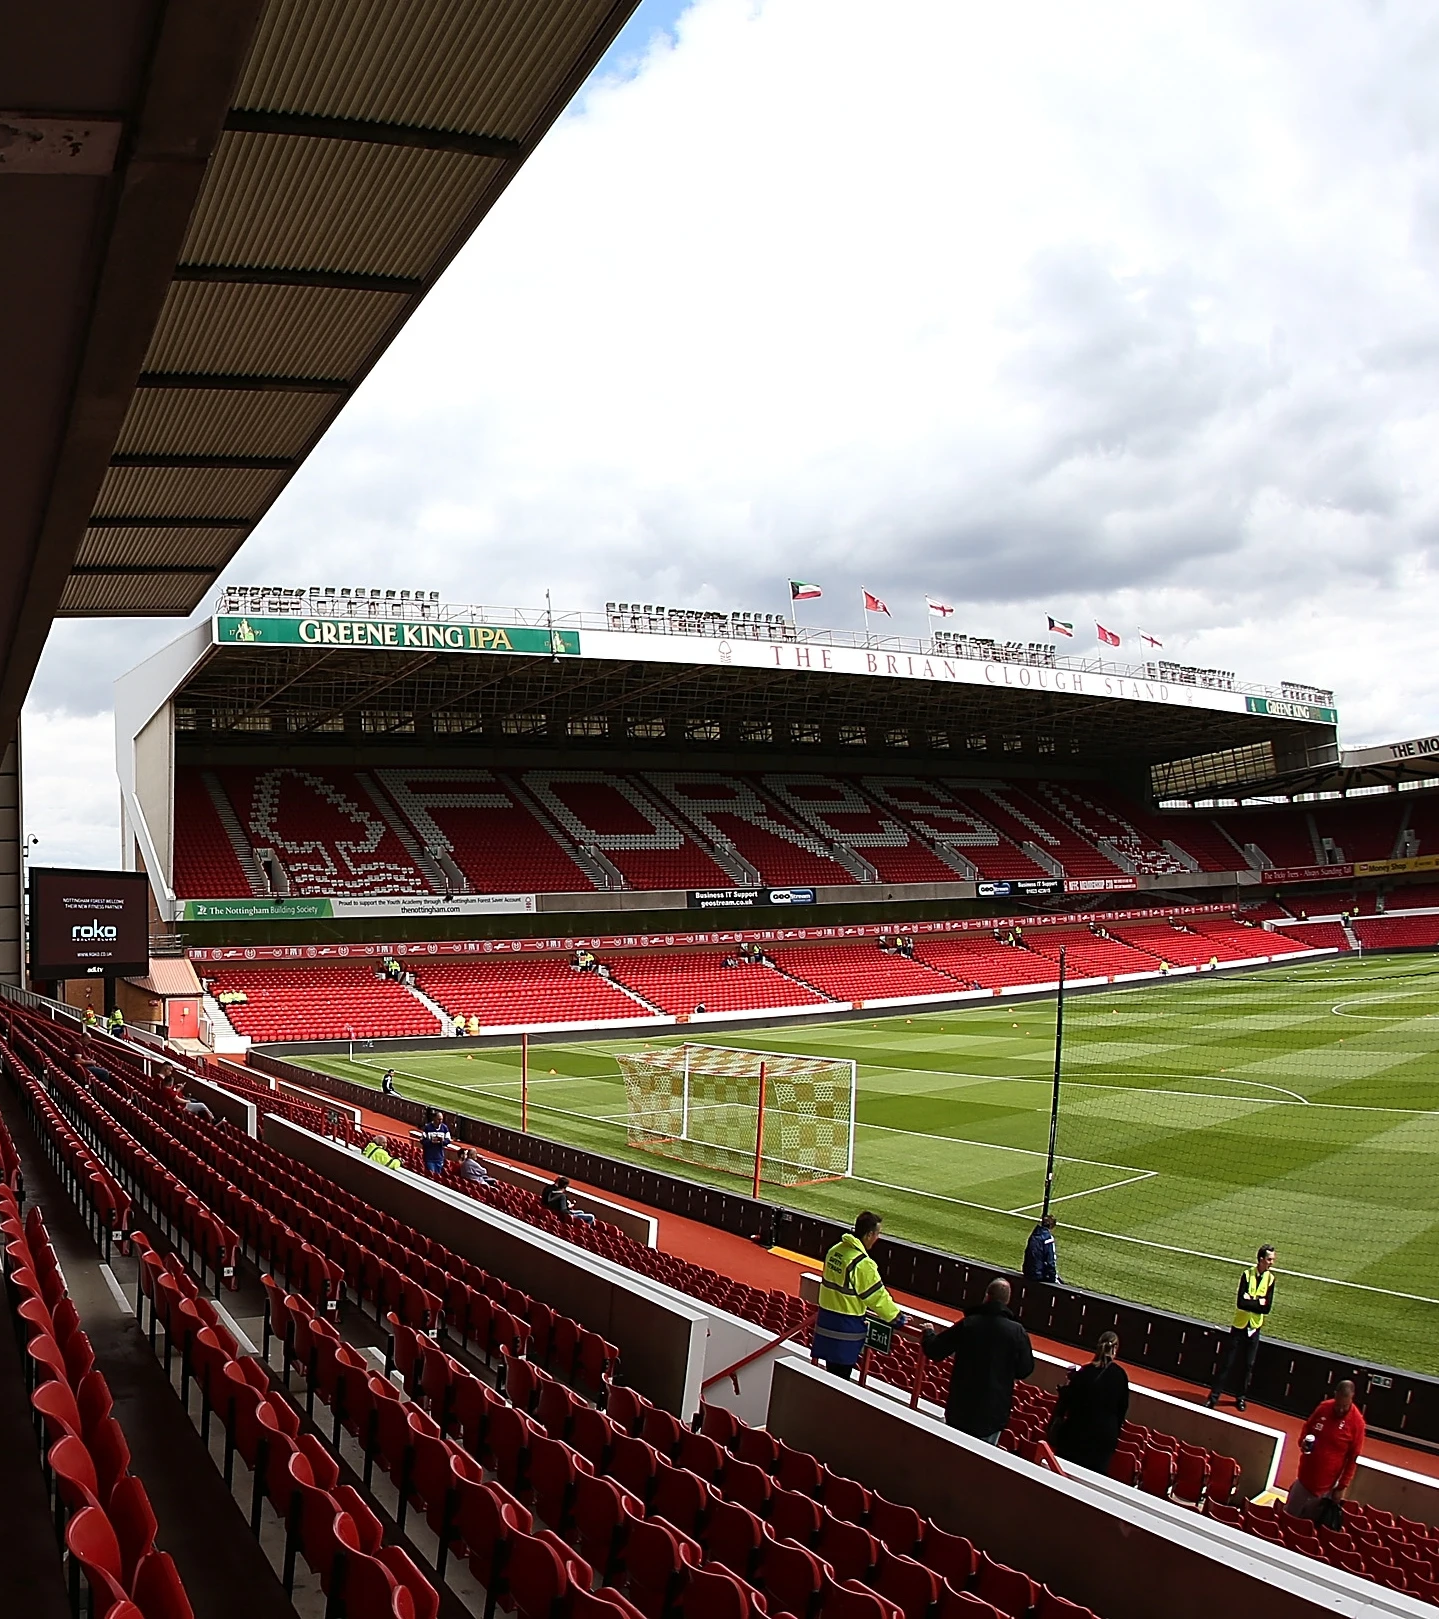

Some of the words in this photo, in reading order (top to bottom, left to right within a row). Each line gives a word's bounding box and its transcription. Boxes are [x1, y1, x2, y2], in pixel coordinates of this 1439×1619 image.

[299, 619, 398, 646] GREENE
[403, 624, 464, 648] KING
[468, 627, 513, 650] IPA
[770, 645, 833, 669] THE
[866, 653, 956, 679] BRIAN
[984, 664, 1083, 692] CLOUGH
[1105, 677, 1169, 701] STAND
[1265, 700, 1293, 717] GREENE
[1293, 703, 1310, 718] KING
[1389, 744, 1415, 758] THE
[1417, 738, 1439, 755] MO
[1320, 867, 1342, 877] Standing
[1368, 864, 1389, 874] Money
[1391, 862, 1407, 872] Shop
[695, 891, 724, 899] Business
[733, 891, 758, 899] Support
[209, 906, 225, 915] The
[225, 906, 269, 917] Nottingham
[270, 905, 296, 916] Building
[296, 905, 318, 915] Society
[401, 905, 460, 914] thenottingham.com
[700, 899, 753, 908] geostream.co.uk
[72, 919, 116, 937] roko
[870, 1328, 888, 1346] Exit
